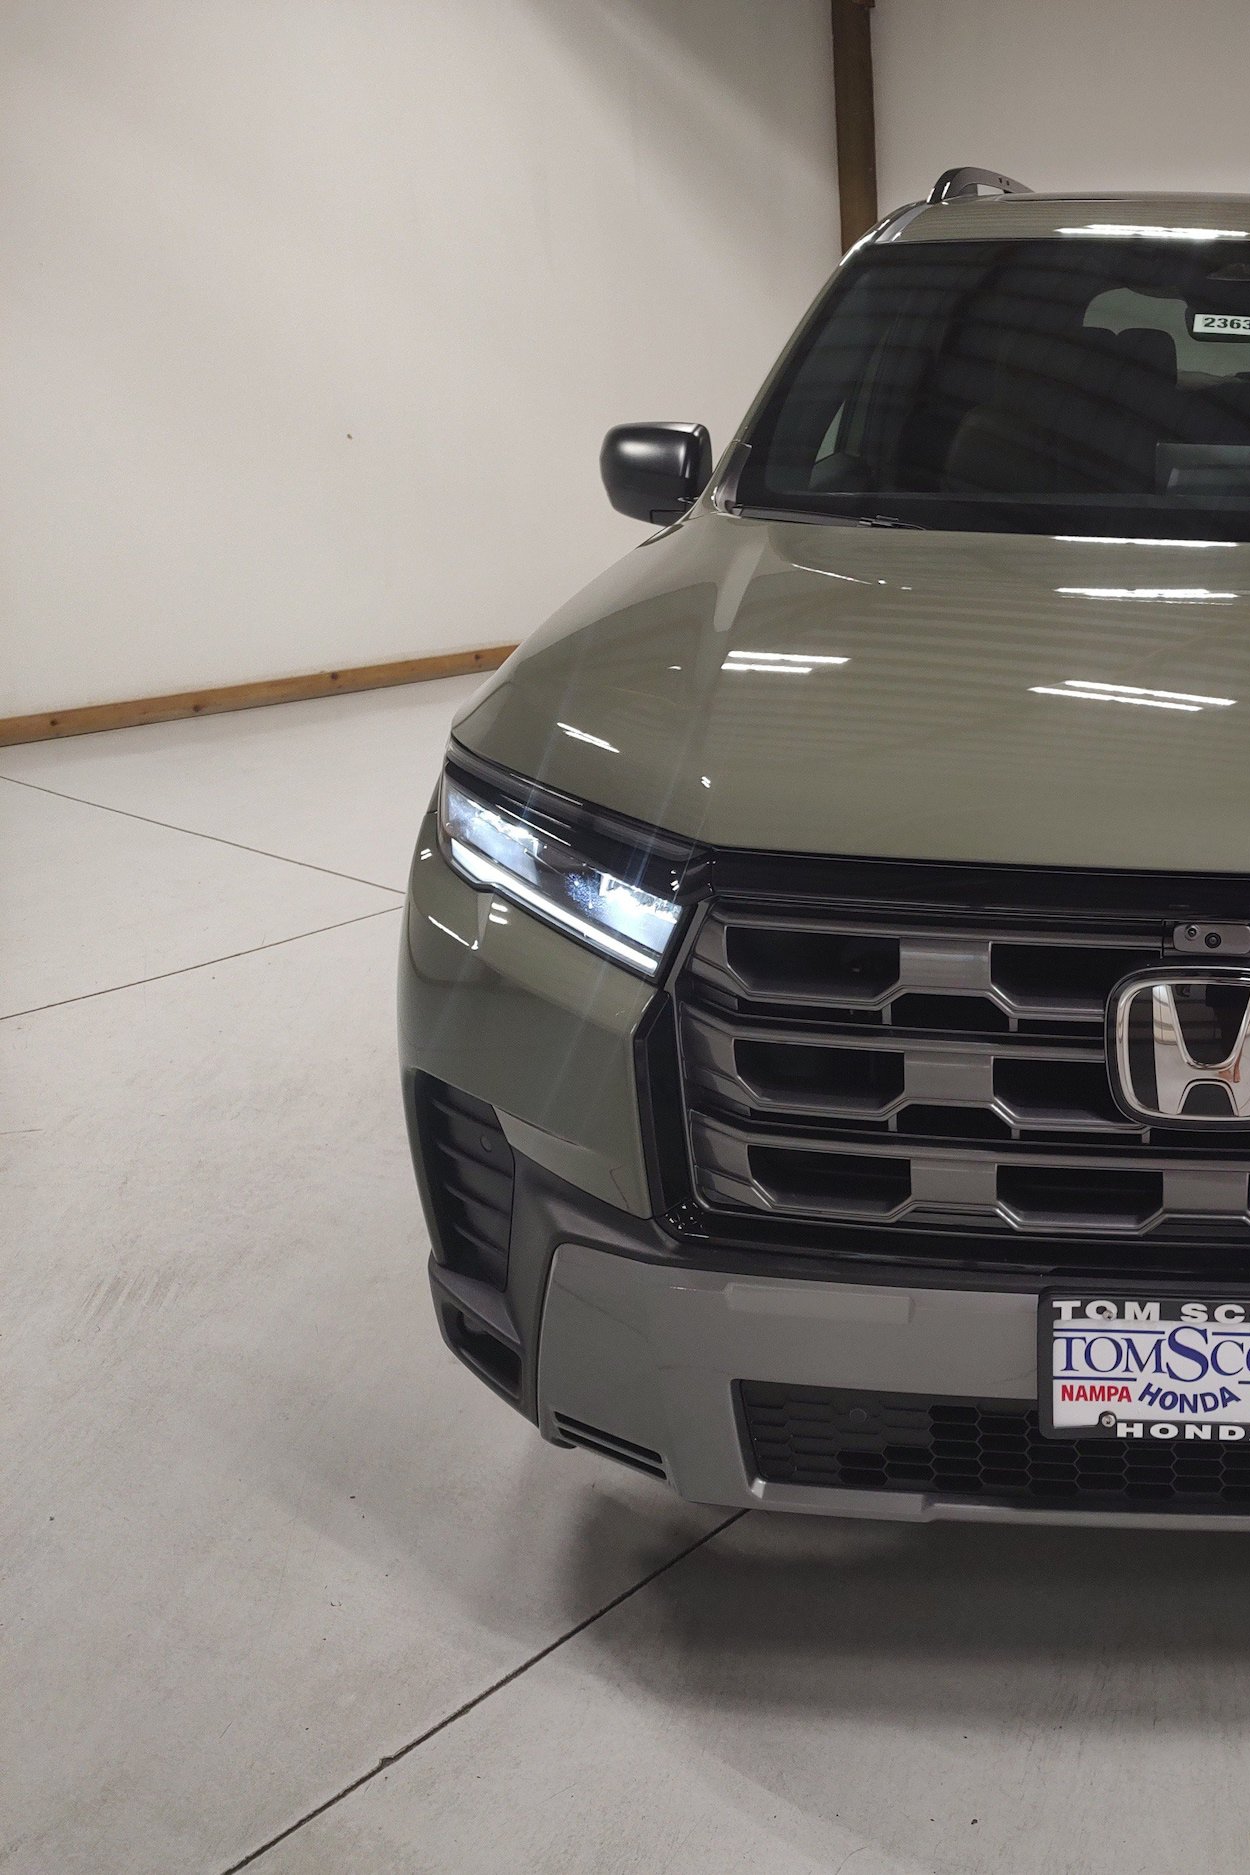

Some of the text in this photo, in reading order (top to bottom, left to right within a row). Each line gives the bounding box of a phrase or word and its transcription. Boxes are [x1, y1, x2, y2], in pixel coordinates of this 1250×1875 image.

[1052, 1300, 1160, 1322] TOM
[1061, 1384, 1132, 1403] NAMPA
[1137, 1382, 1241, 1414] HONDA
